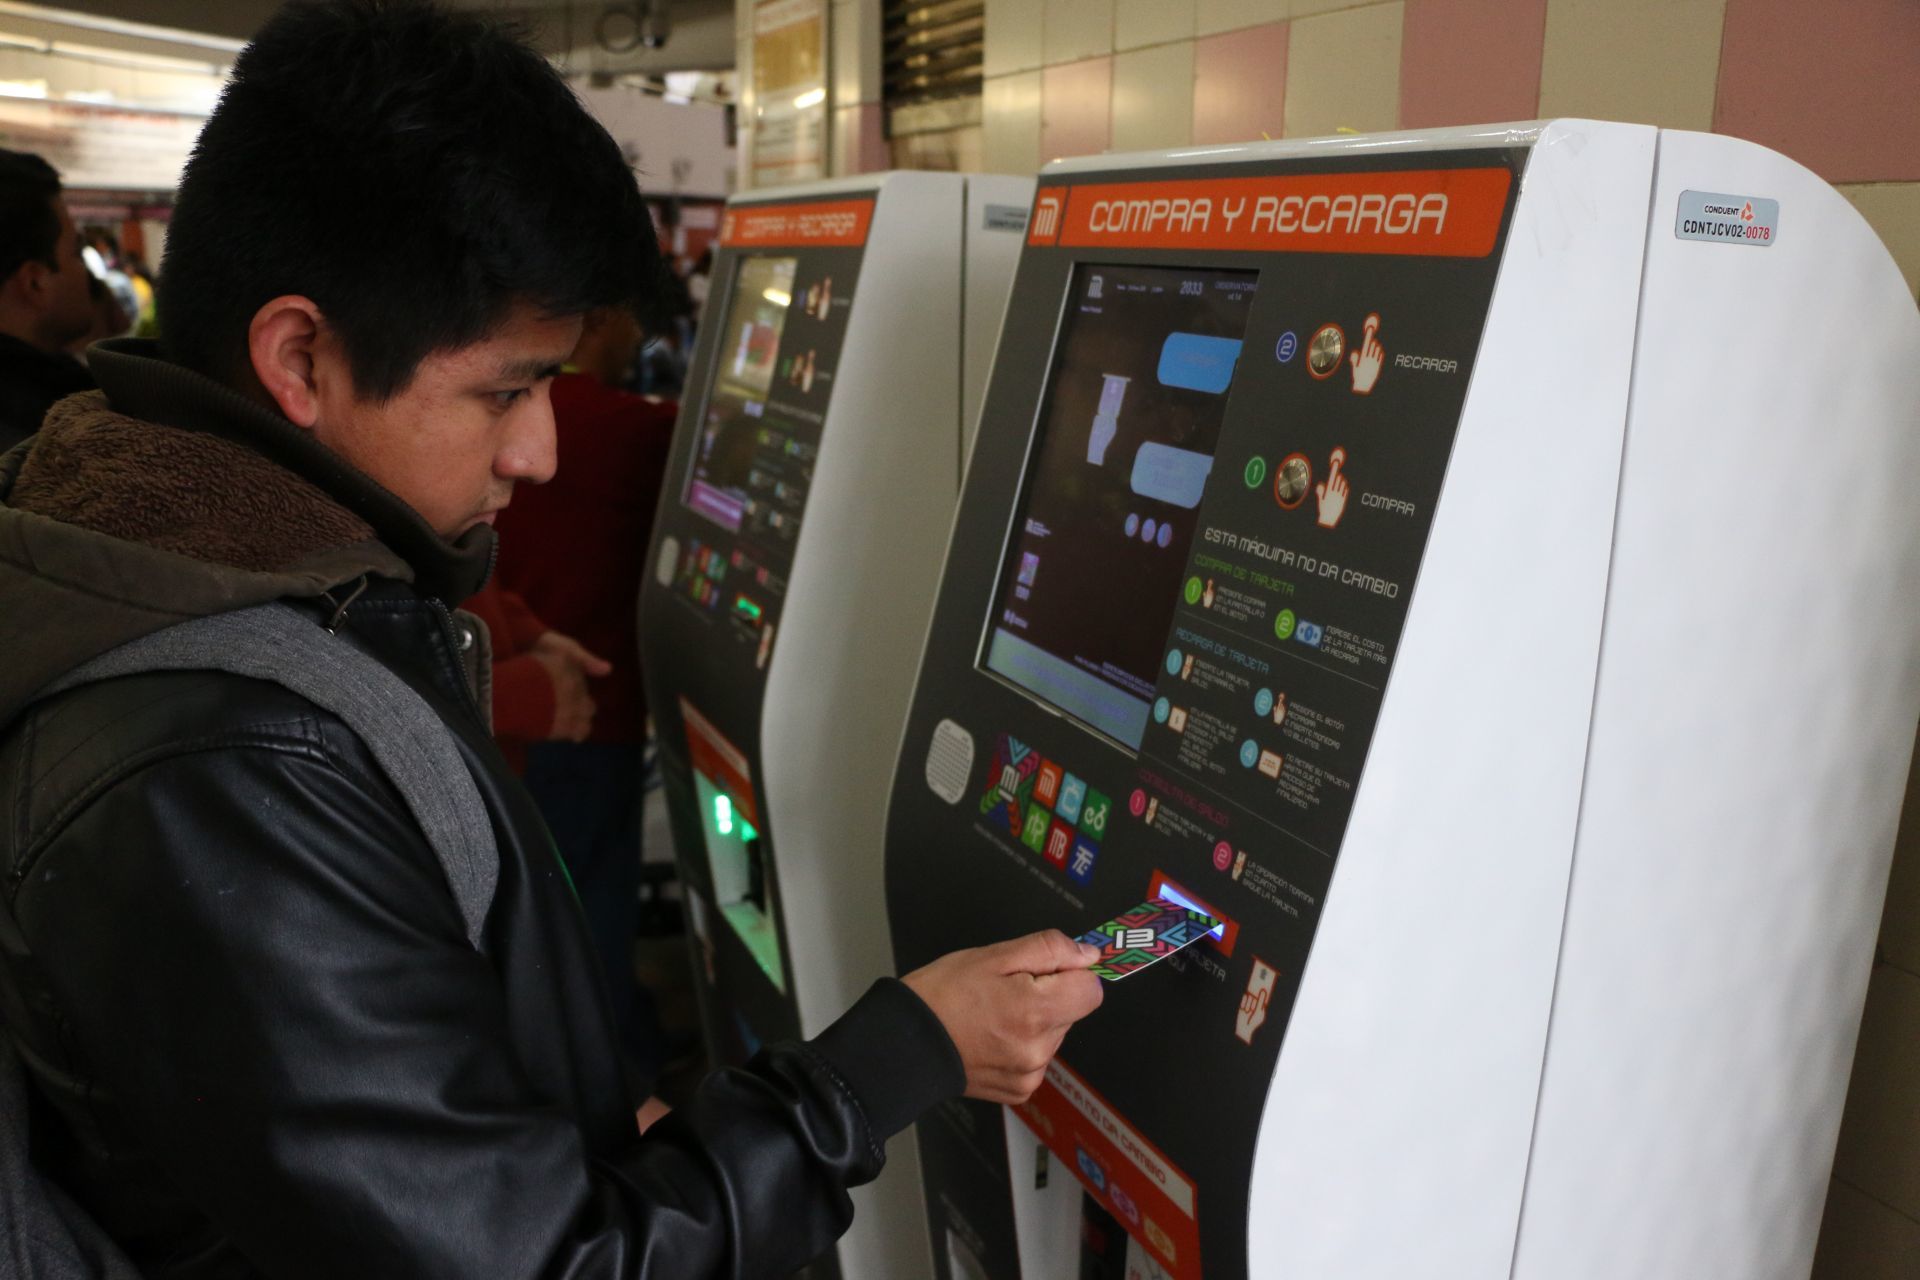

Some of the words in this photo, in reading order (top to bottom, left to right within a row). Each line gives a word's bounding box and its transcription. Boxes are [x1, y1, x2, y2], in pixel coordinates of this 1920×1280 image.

[1089, 197, 1212, 234] COMPRA
[1221, 196, 1246, 233] Y
[1251, 193, 1450, 235] RECARGA
[1704, 205, 1740, 216] CONDUENT
[1683, 220, 1770, 241] CDNTJCV02-0078
[1281, 339, 1292, 355] 2
[1395, 354, 1458, 374] RECARGA
[1361, 492, 1416, 517] COMPRA
[1204, 528, 1237, 549] ESTA
[1239, 535, 1295, 567] MÁQUINA
[1297, 554, 1317, 574] NO
[1318, 561, 1340, 582] DA
[1341, 568, 1400, 599] CAMBIO
[1233, 565, 1248, 581] DE
[1249, 568, 1296, 596] TARJETA
[1280, 616, 1290, 632] 2
[1229, 649, 1270, 675] TARJETA
